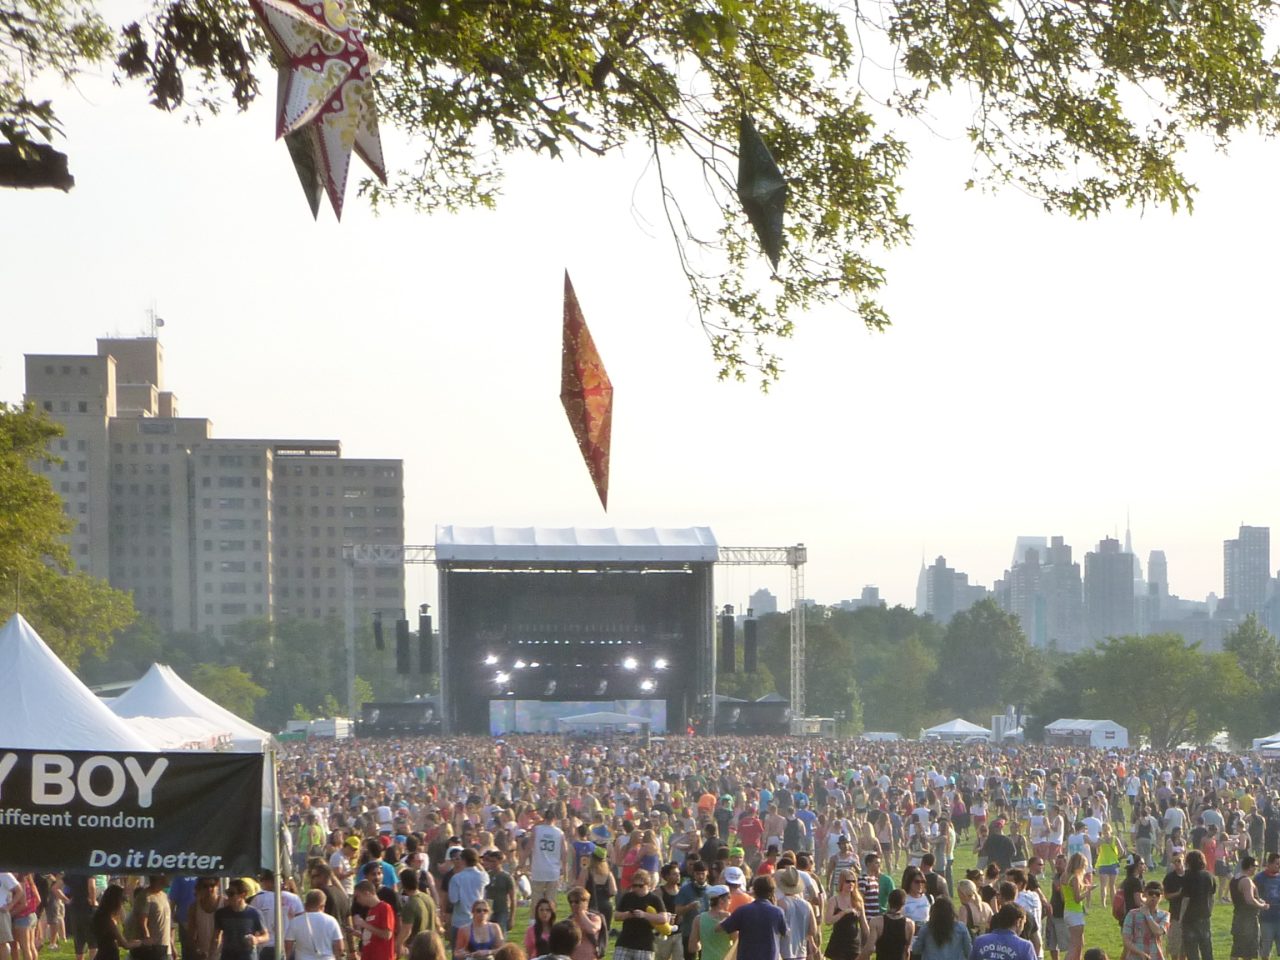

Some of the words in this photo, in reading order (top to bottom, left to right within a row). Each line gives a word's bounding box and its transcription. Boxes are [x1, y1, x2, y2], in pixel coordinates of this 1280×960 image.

[31, 753, 169, 808] BOY
[77, 812, 155, 828] condom
[540, 839, 555, 851] 33
[89, 849, 121, 868] Do
[125, 849, 144, 868] it
[147, 849, 225, 869] better.
